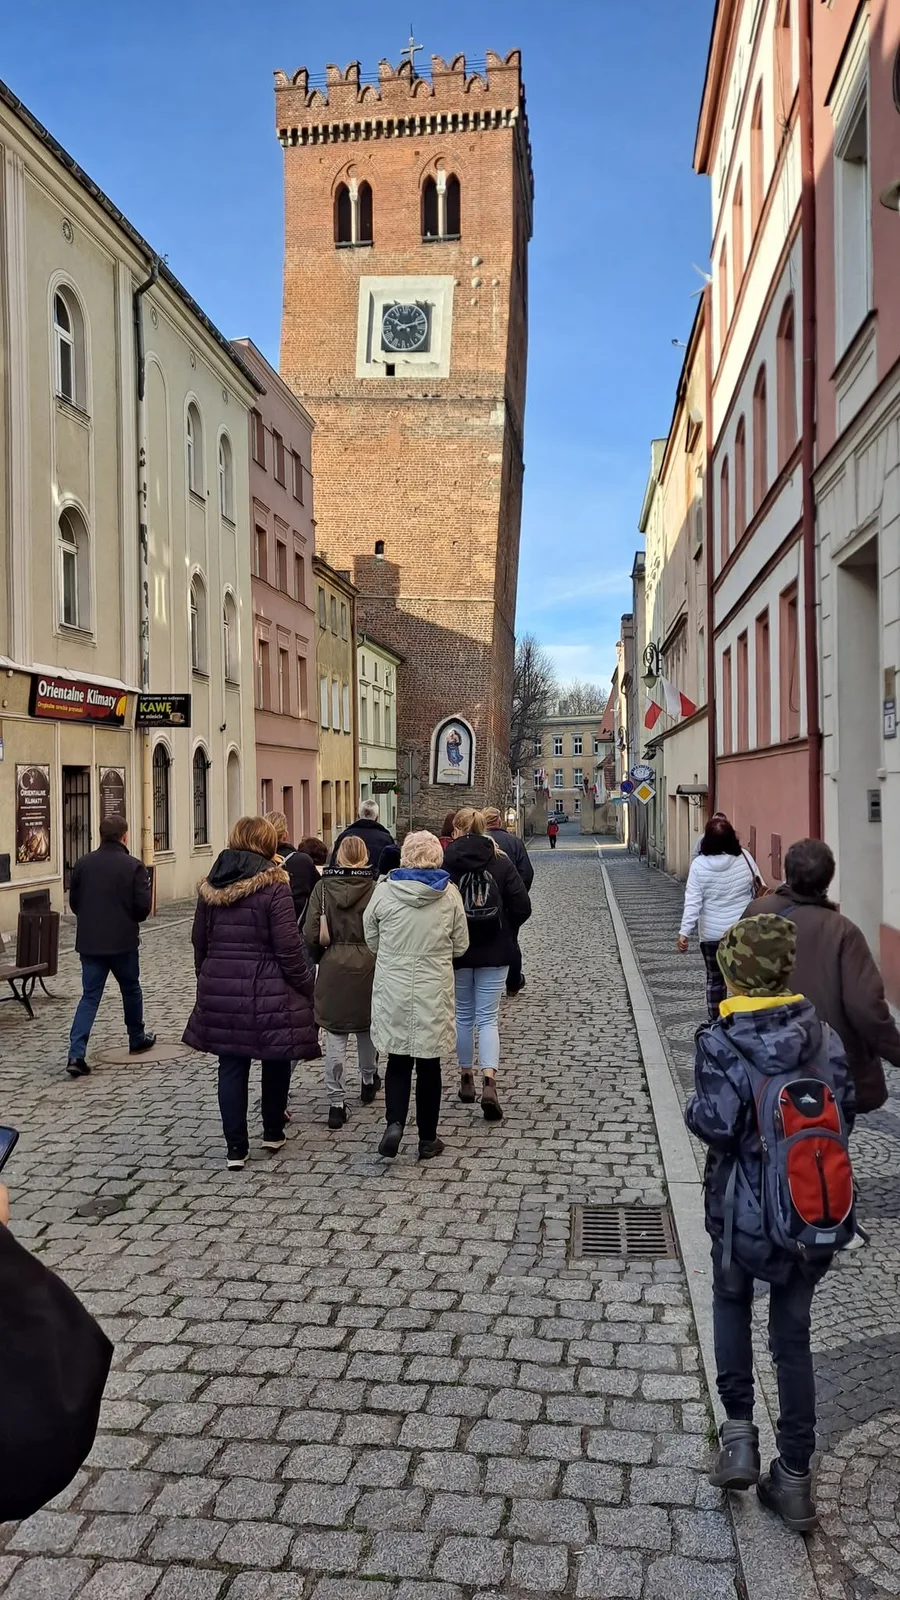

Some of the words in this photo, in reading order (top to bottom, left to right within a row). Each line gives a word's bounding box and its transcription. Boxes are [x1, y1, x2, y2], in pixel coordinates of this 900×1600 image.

[38, 680, 84, 702] Orientalne
[86, 688, 116, 710] Klimaty
[140, 702, 172, 714] KAWĘ
